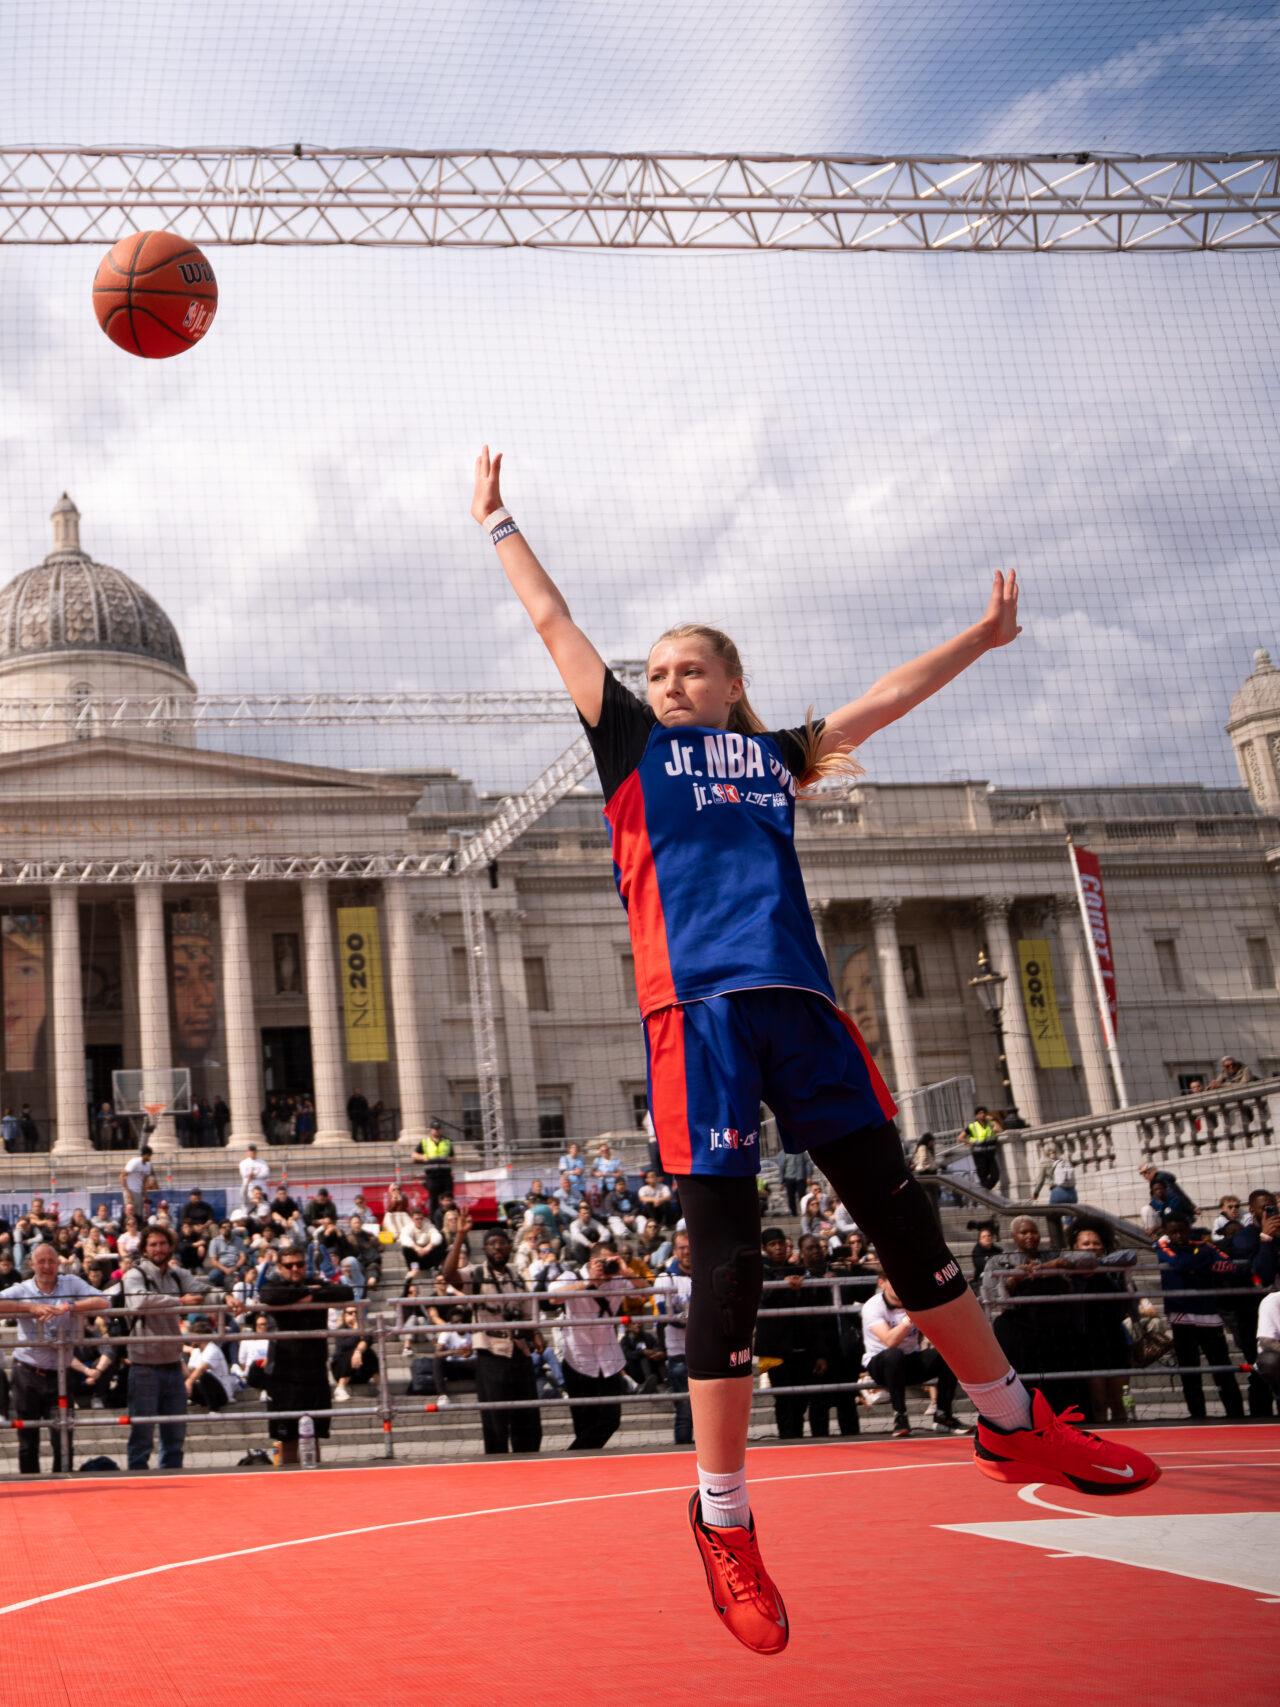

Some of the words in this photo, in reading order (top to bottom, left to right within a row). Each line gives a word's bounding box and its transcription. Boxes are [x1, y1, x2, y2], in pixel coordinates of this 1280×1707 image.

[664, 739, 703, 777] Jr.
[704, 733, 765, 779] NBA
[347, 933, 371, 1028] NG200
[940, 1259, 960, 1281] NBA
